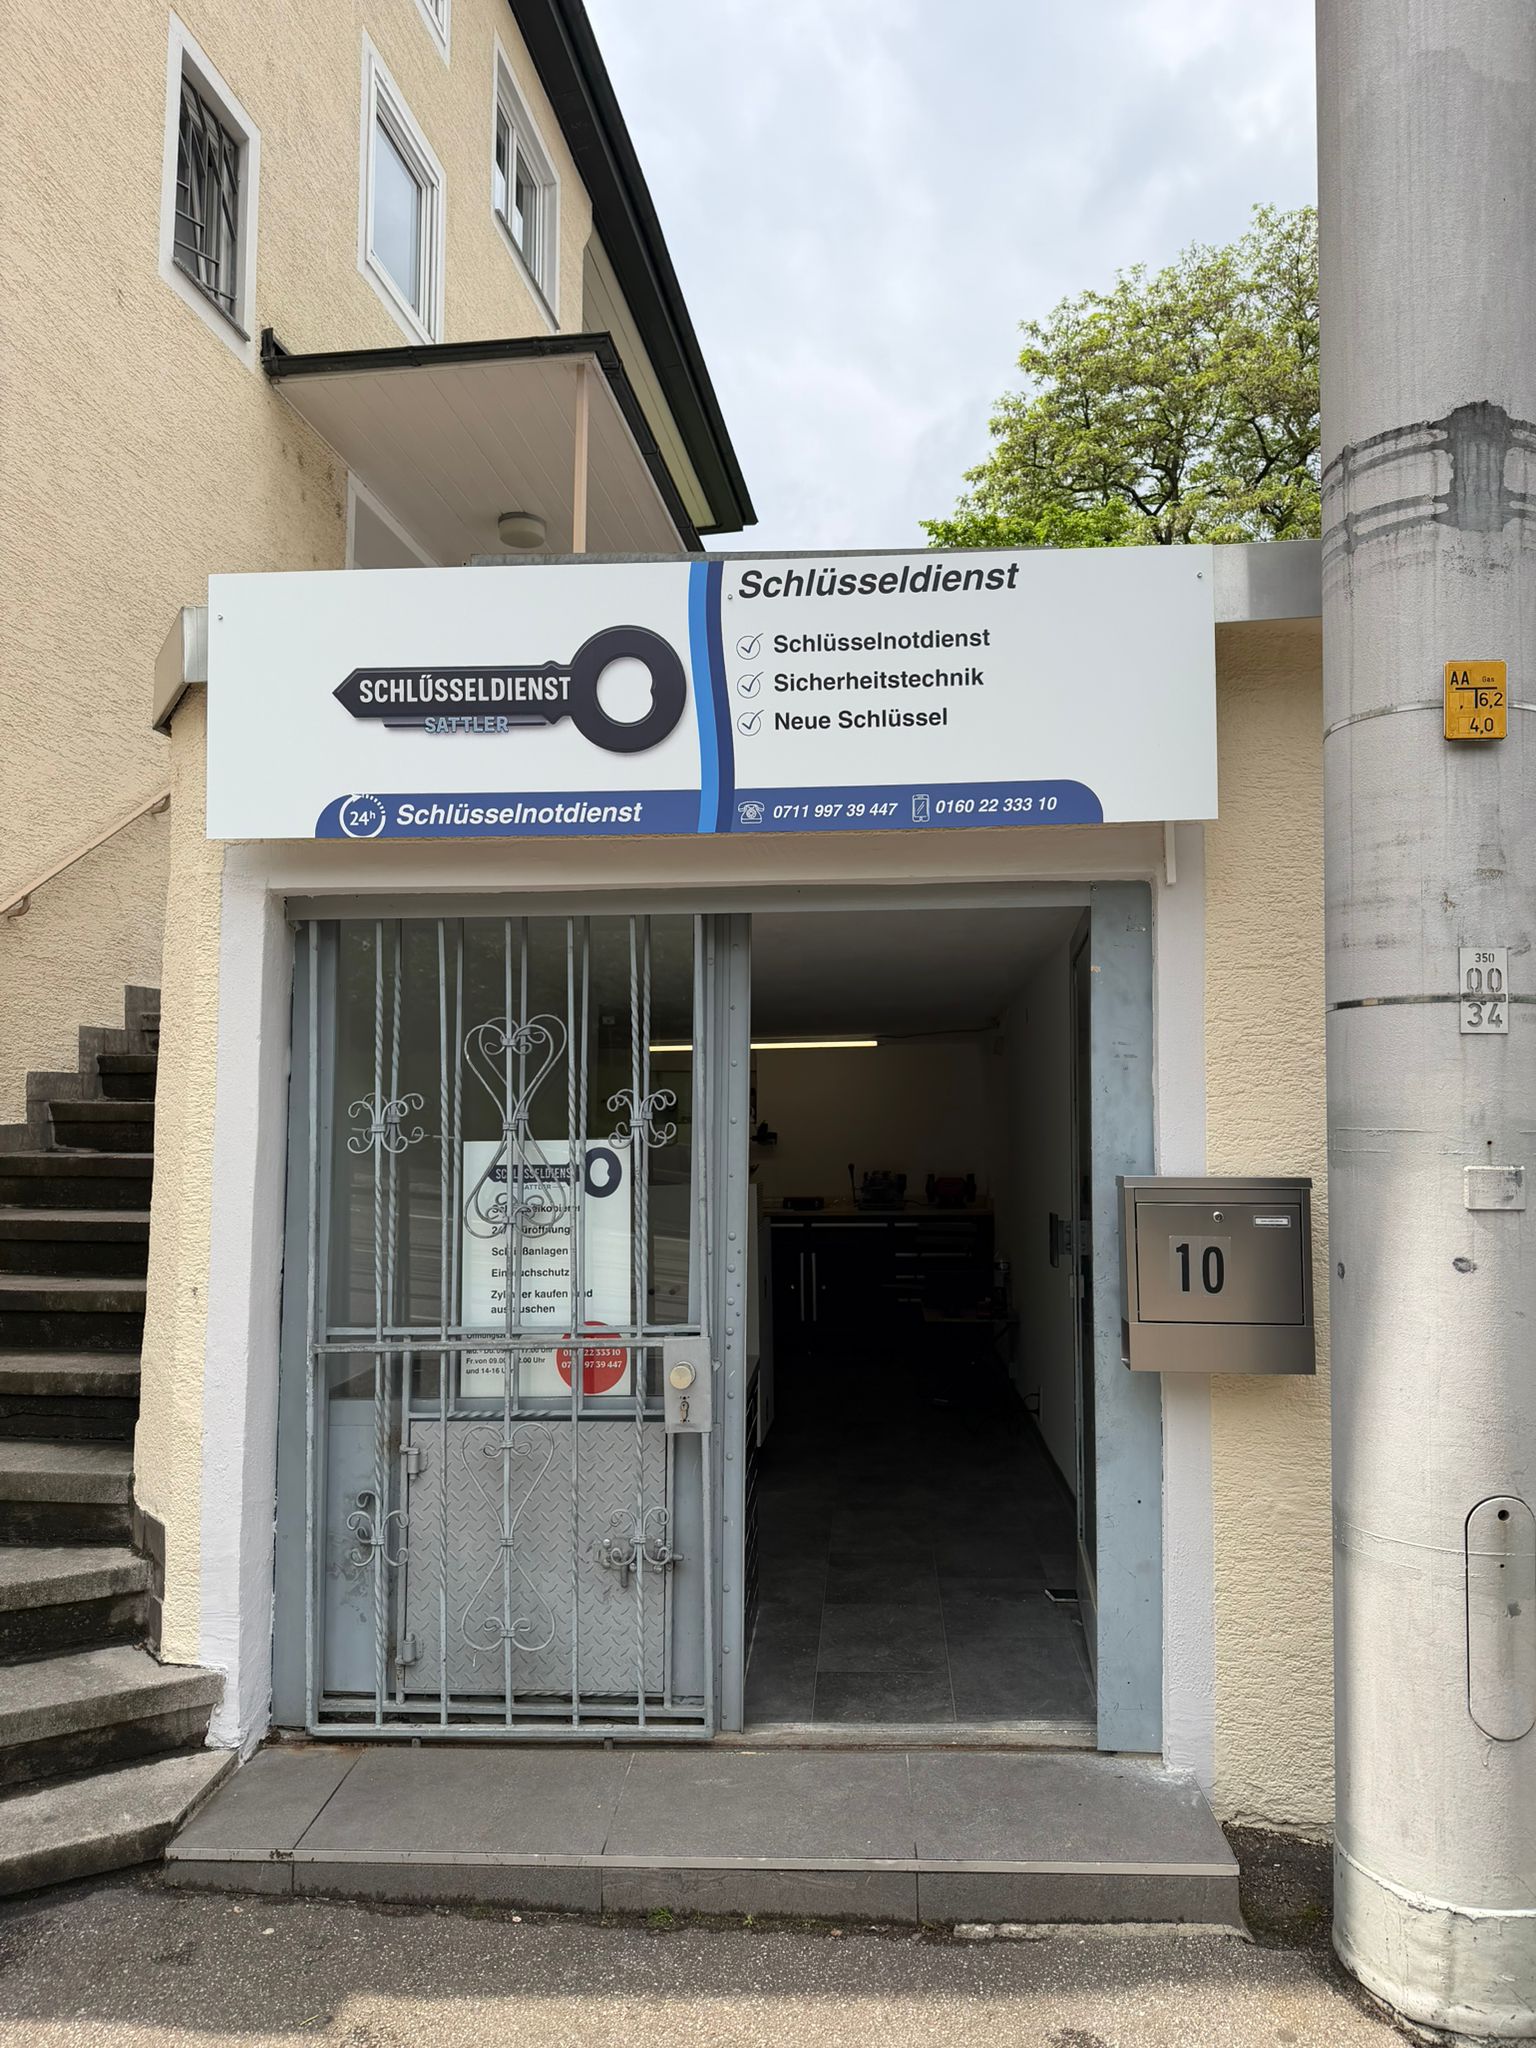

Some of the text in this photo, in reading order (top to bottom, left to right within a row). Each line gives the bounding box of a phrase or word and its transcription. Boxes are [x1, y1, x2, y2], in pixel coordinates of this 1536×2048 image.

[738, 563, 1019, 599] Schlüsseldienst
[774, 629, 990, 653] Schlüsselnotdienst
[774, 668, 984, 692] Sicherheitstechnik
[1450, 671, 1469, 685] AA
[359, 674, 571, 703] SCHLÜSSELDIENST
[1479, 692, 1503, 709] 6,2
[424, 716, 510, 734] SATTLER
[775, 708, 948, 730] Neue Schlüssel
[1470, 718, 1493, 734] 4,0
[773, 802, 898, 819] 0711 997 39 447
[936, 797, 1058, 814] 0160 22 333 10
[396, 802, 643, 827] Schlüsselnotdienst
[1475, 953, 1495, 963] 350
[1466, 968, 1502, 993] 00
[1467, 1003, 1503, 1028] 34
[496, 1168, 572, 1179] SCLSSELDIENS
[492, 1247, 569, 1257] Scißanlagen
[492, 1268, 570, 1277] Einuchschutz
[1176, 1243, 1225, 1294] 10
[535, 1289, 568, 1298] kaufen
[491, 1304, 555, 1313] aususchen
